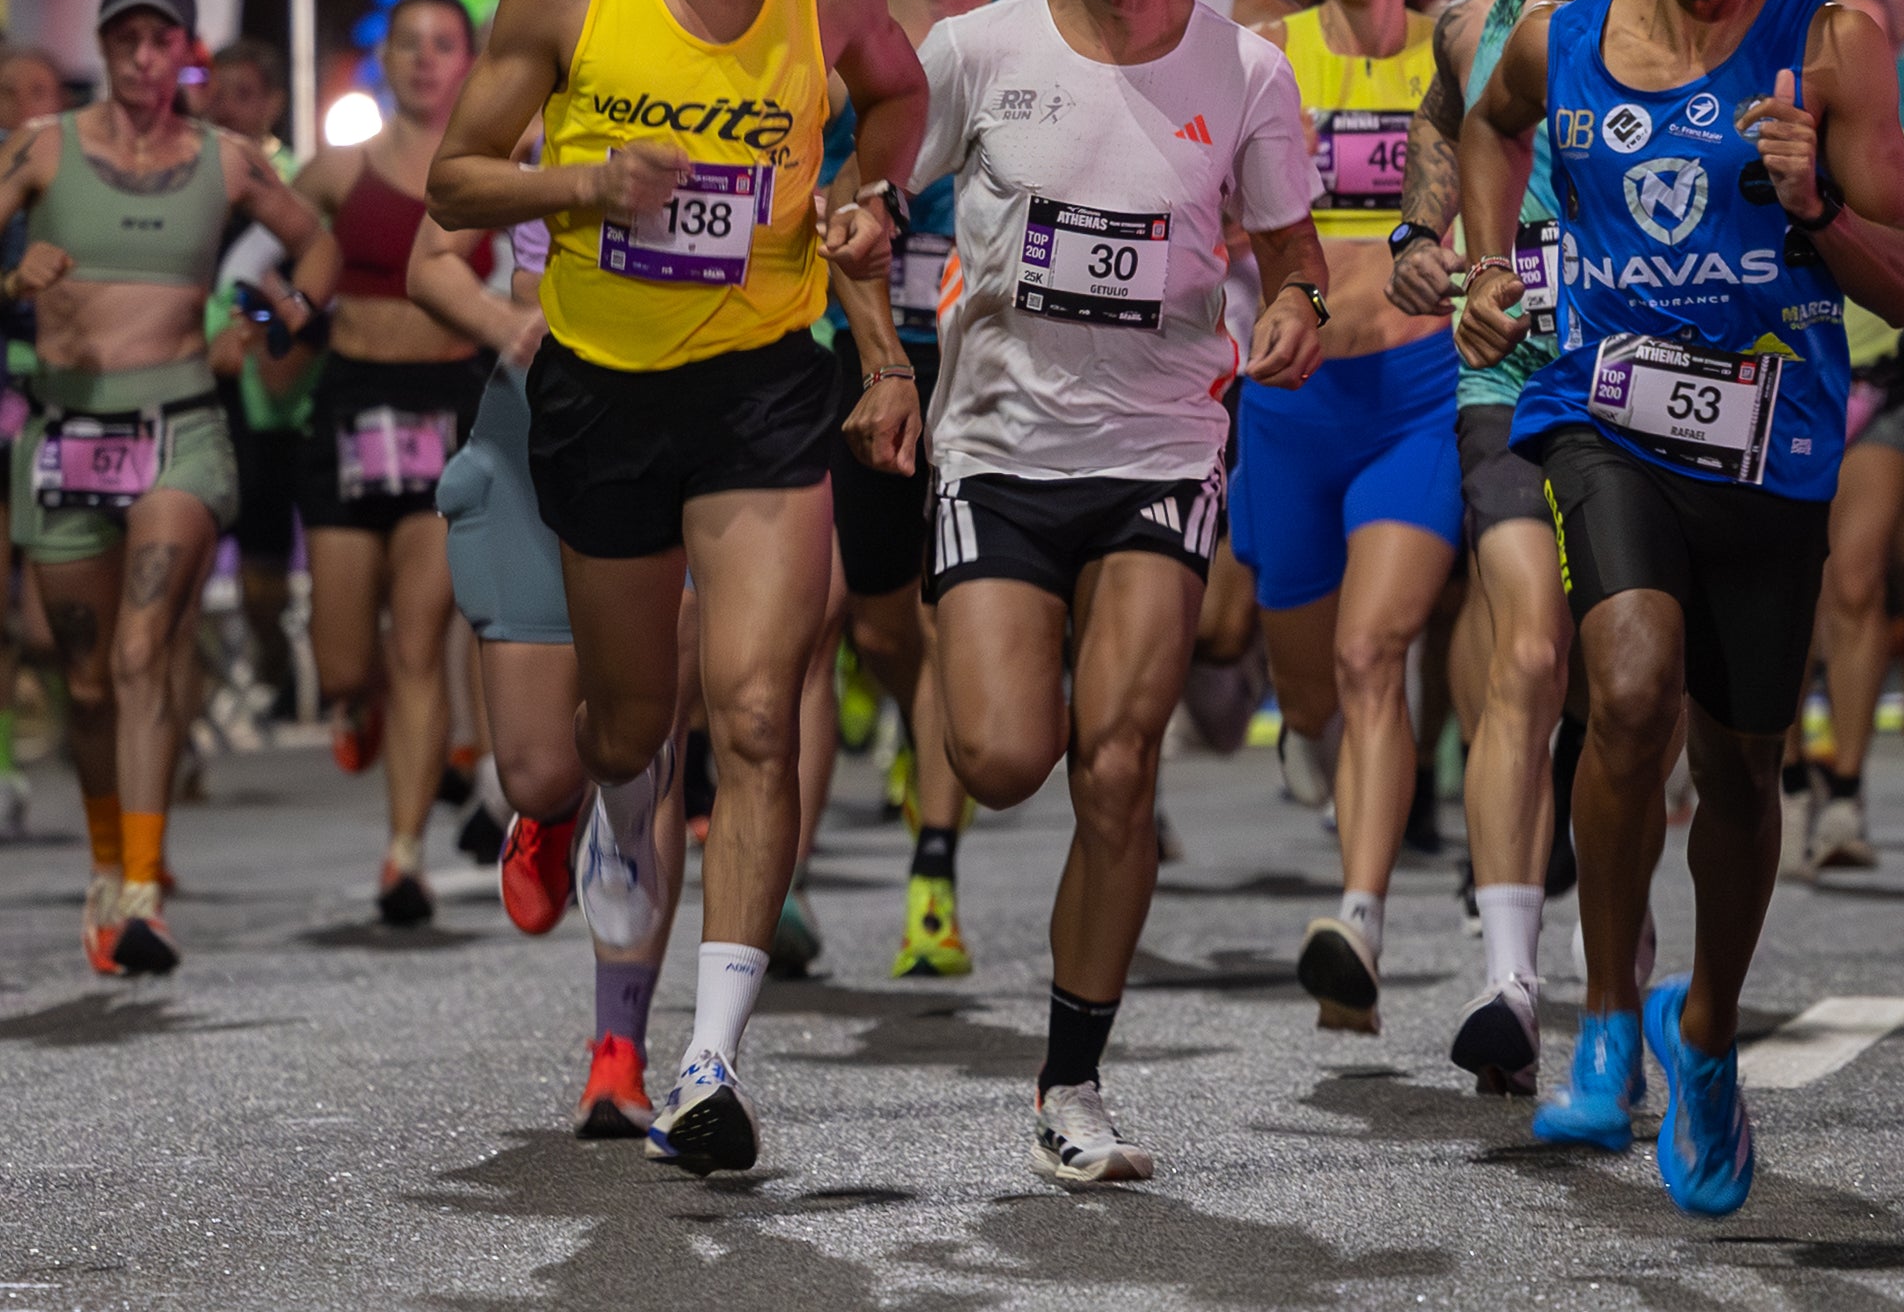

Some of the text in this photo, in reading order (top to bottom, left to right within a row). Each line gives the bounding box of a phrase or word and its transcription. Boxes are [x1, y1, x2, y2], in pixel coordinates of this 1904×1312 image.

[594, 93, 794, 149] velocità
[1002, 110, 1032, 121] RUN
[663, 196, 732, 238] 138
[1056, 209, 1109, 232] ATHENAS
[1026, 230, 1049, 247] TOP
[1025, 244, 1047, 260] 200
[1088, 243, 1139, 281] 30
[1517, 255, 1540, 271] TOP
[1582, 249, 1780, 290] NAVAS
[1023, 269, 1044, 285] 25K
[1090, 283, 1129, 297] GETULIO
[1635, 344, 1691, 368] ATHENAS
[1601, 368, 1626, 385] TOP
[1598, 384, 1622, 401] 200
[1666, 380, 1722, 424] 53
[1670, 424, 1706, 441] RAFAEL
